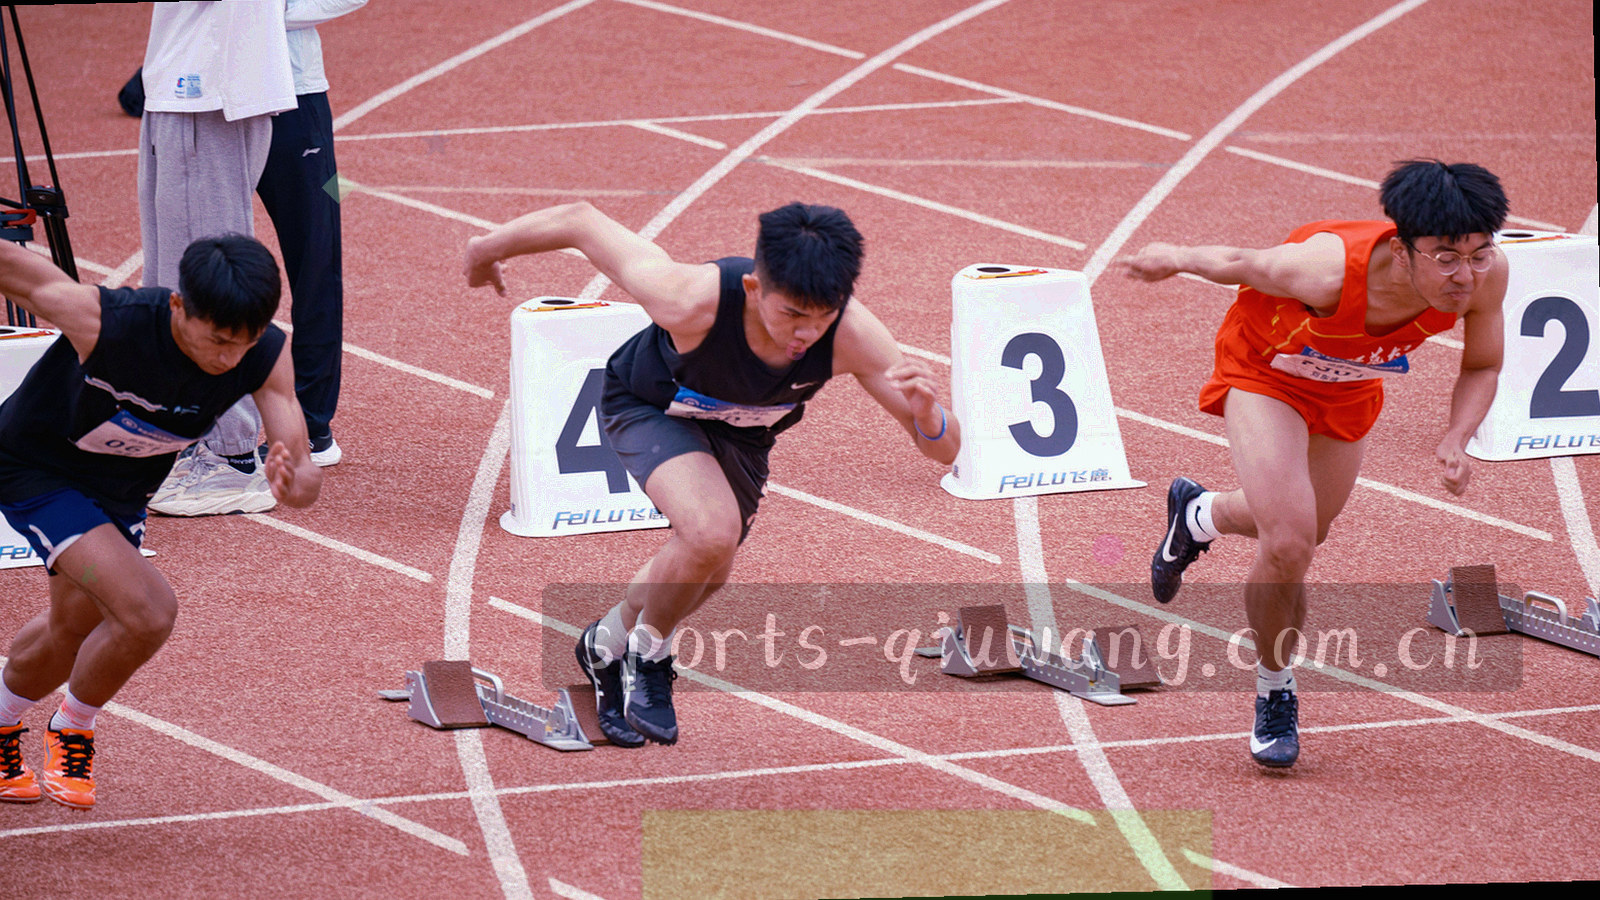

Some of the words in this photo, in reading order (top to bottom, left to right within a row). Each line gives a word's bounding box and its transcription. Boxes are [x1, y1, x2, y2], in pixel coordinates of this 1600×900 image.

[1001, 332, 1078, 457] 3
[1520, 296, 1600, 418] 2
[555, 368, 631, 494] 4
